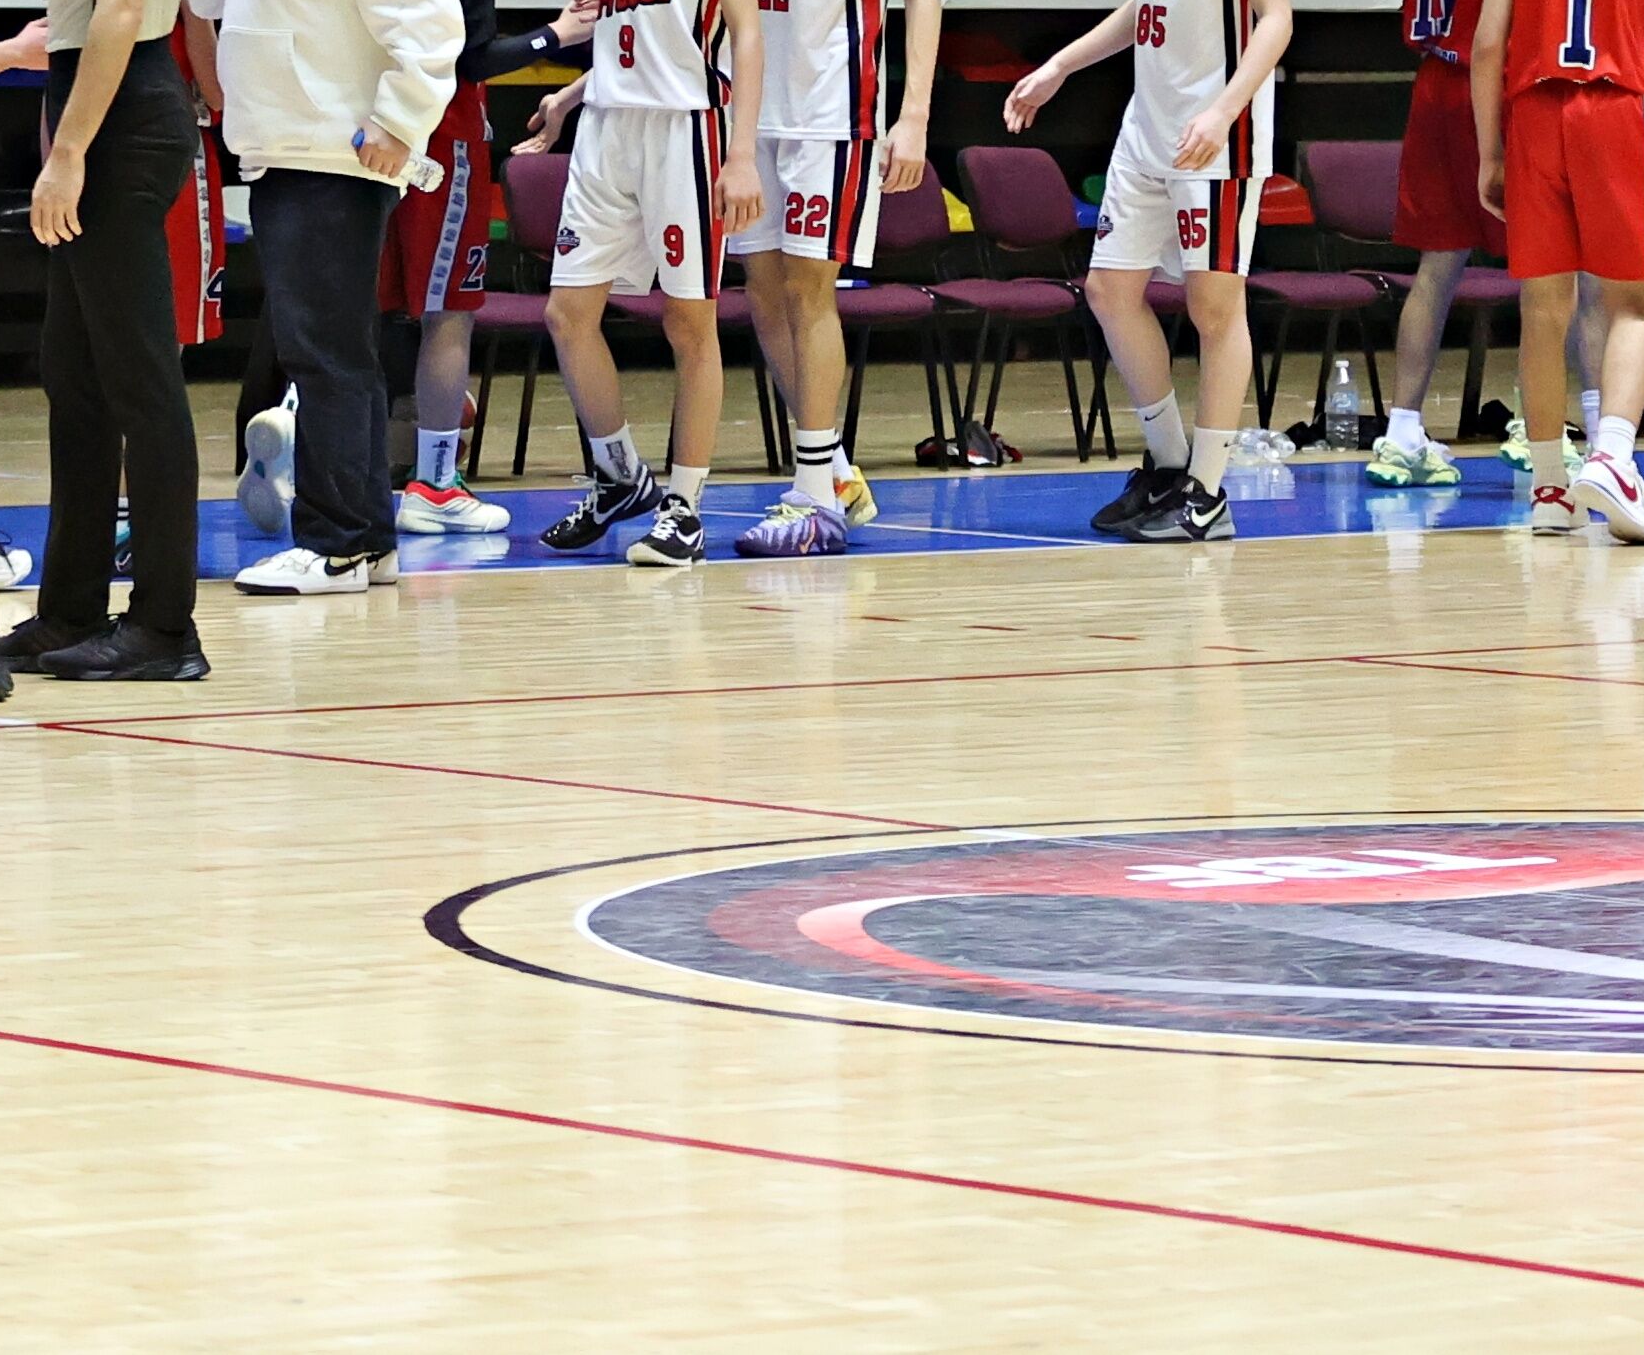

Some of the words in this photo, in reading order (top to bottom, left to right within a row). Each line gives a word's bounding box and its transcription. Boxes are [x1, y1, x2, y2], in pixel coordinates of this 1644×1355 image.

[618, 24, 636, 69] 9
[1137, 3, 1167, 48] 85
[784, 191, 830, 238] 22
[1176, 208, 1209, 250] 85
[663, 224, 686, 268] 9
